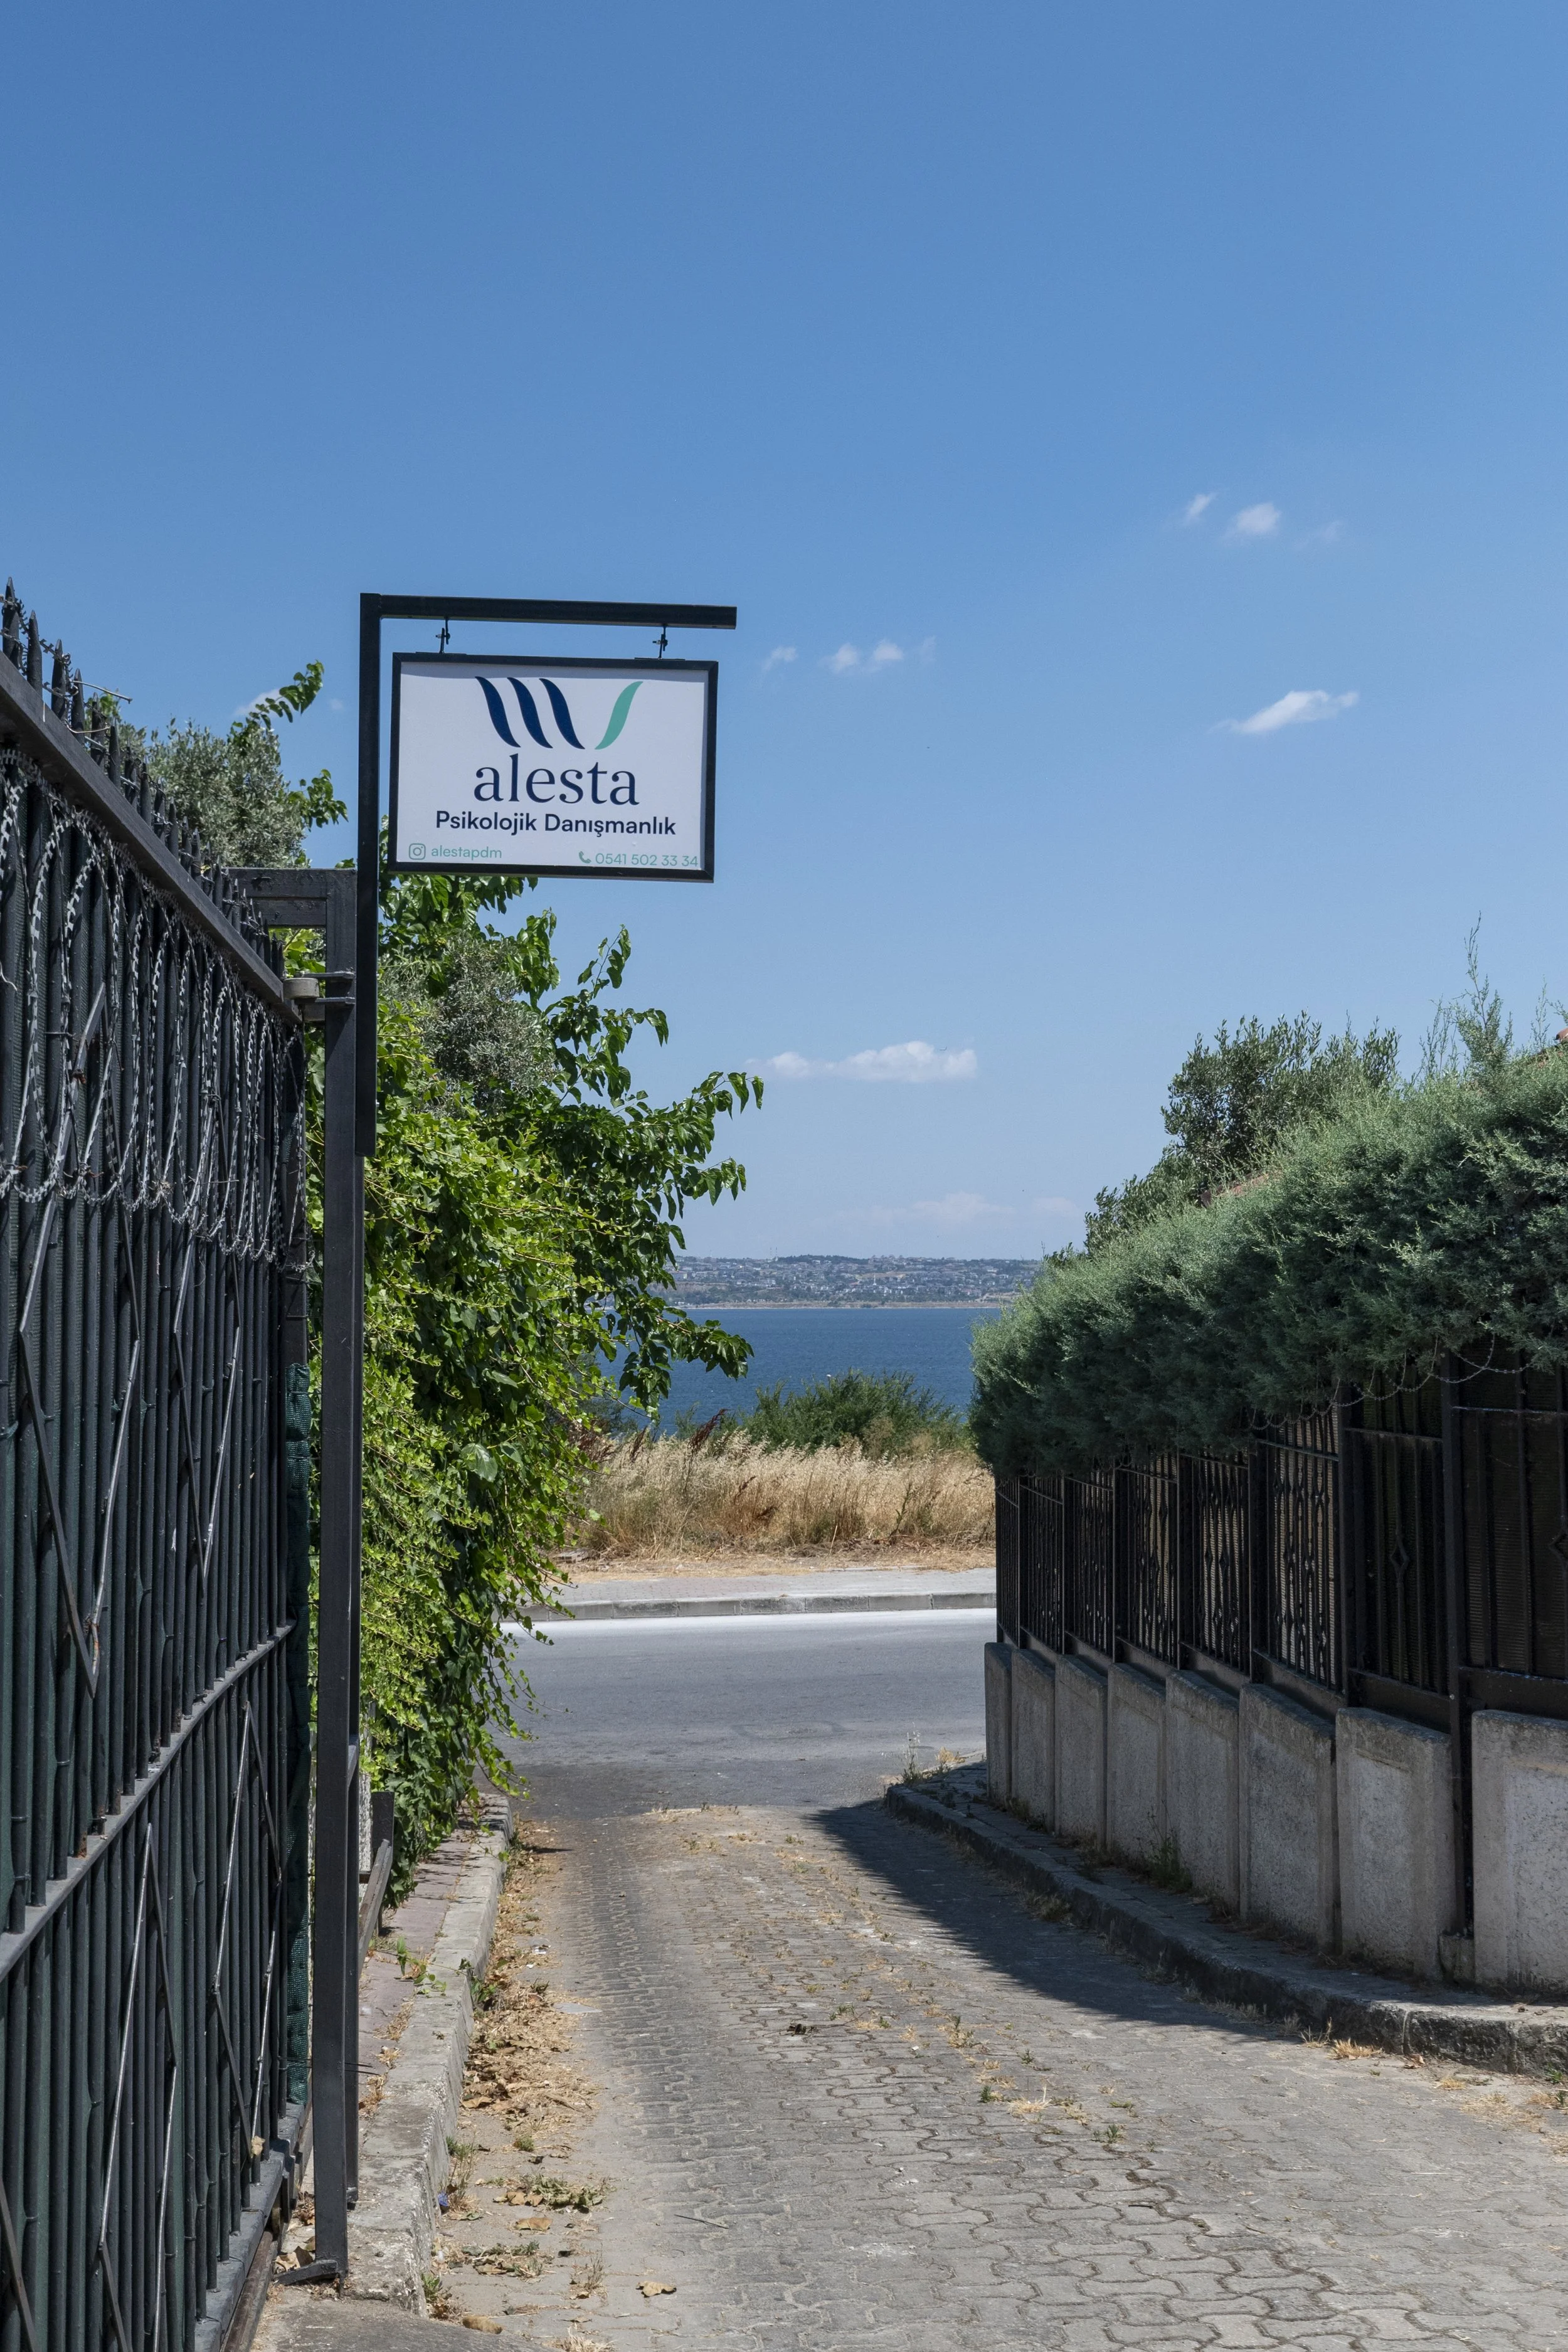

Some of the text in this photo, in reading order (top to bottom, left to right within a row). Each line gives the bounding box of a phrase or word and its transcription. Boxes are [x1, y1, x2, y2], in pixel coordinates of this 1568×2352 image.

[473, 753, 640, 806] alesta
[436, 810, 676, 837] Psikolojik Danışmanlık
[431, 845, 502, 861] alestapdm
[595, 852, 698, 867] 0541 502 33 34
